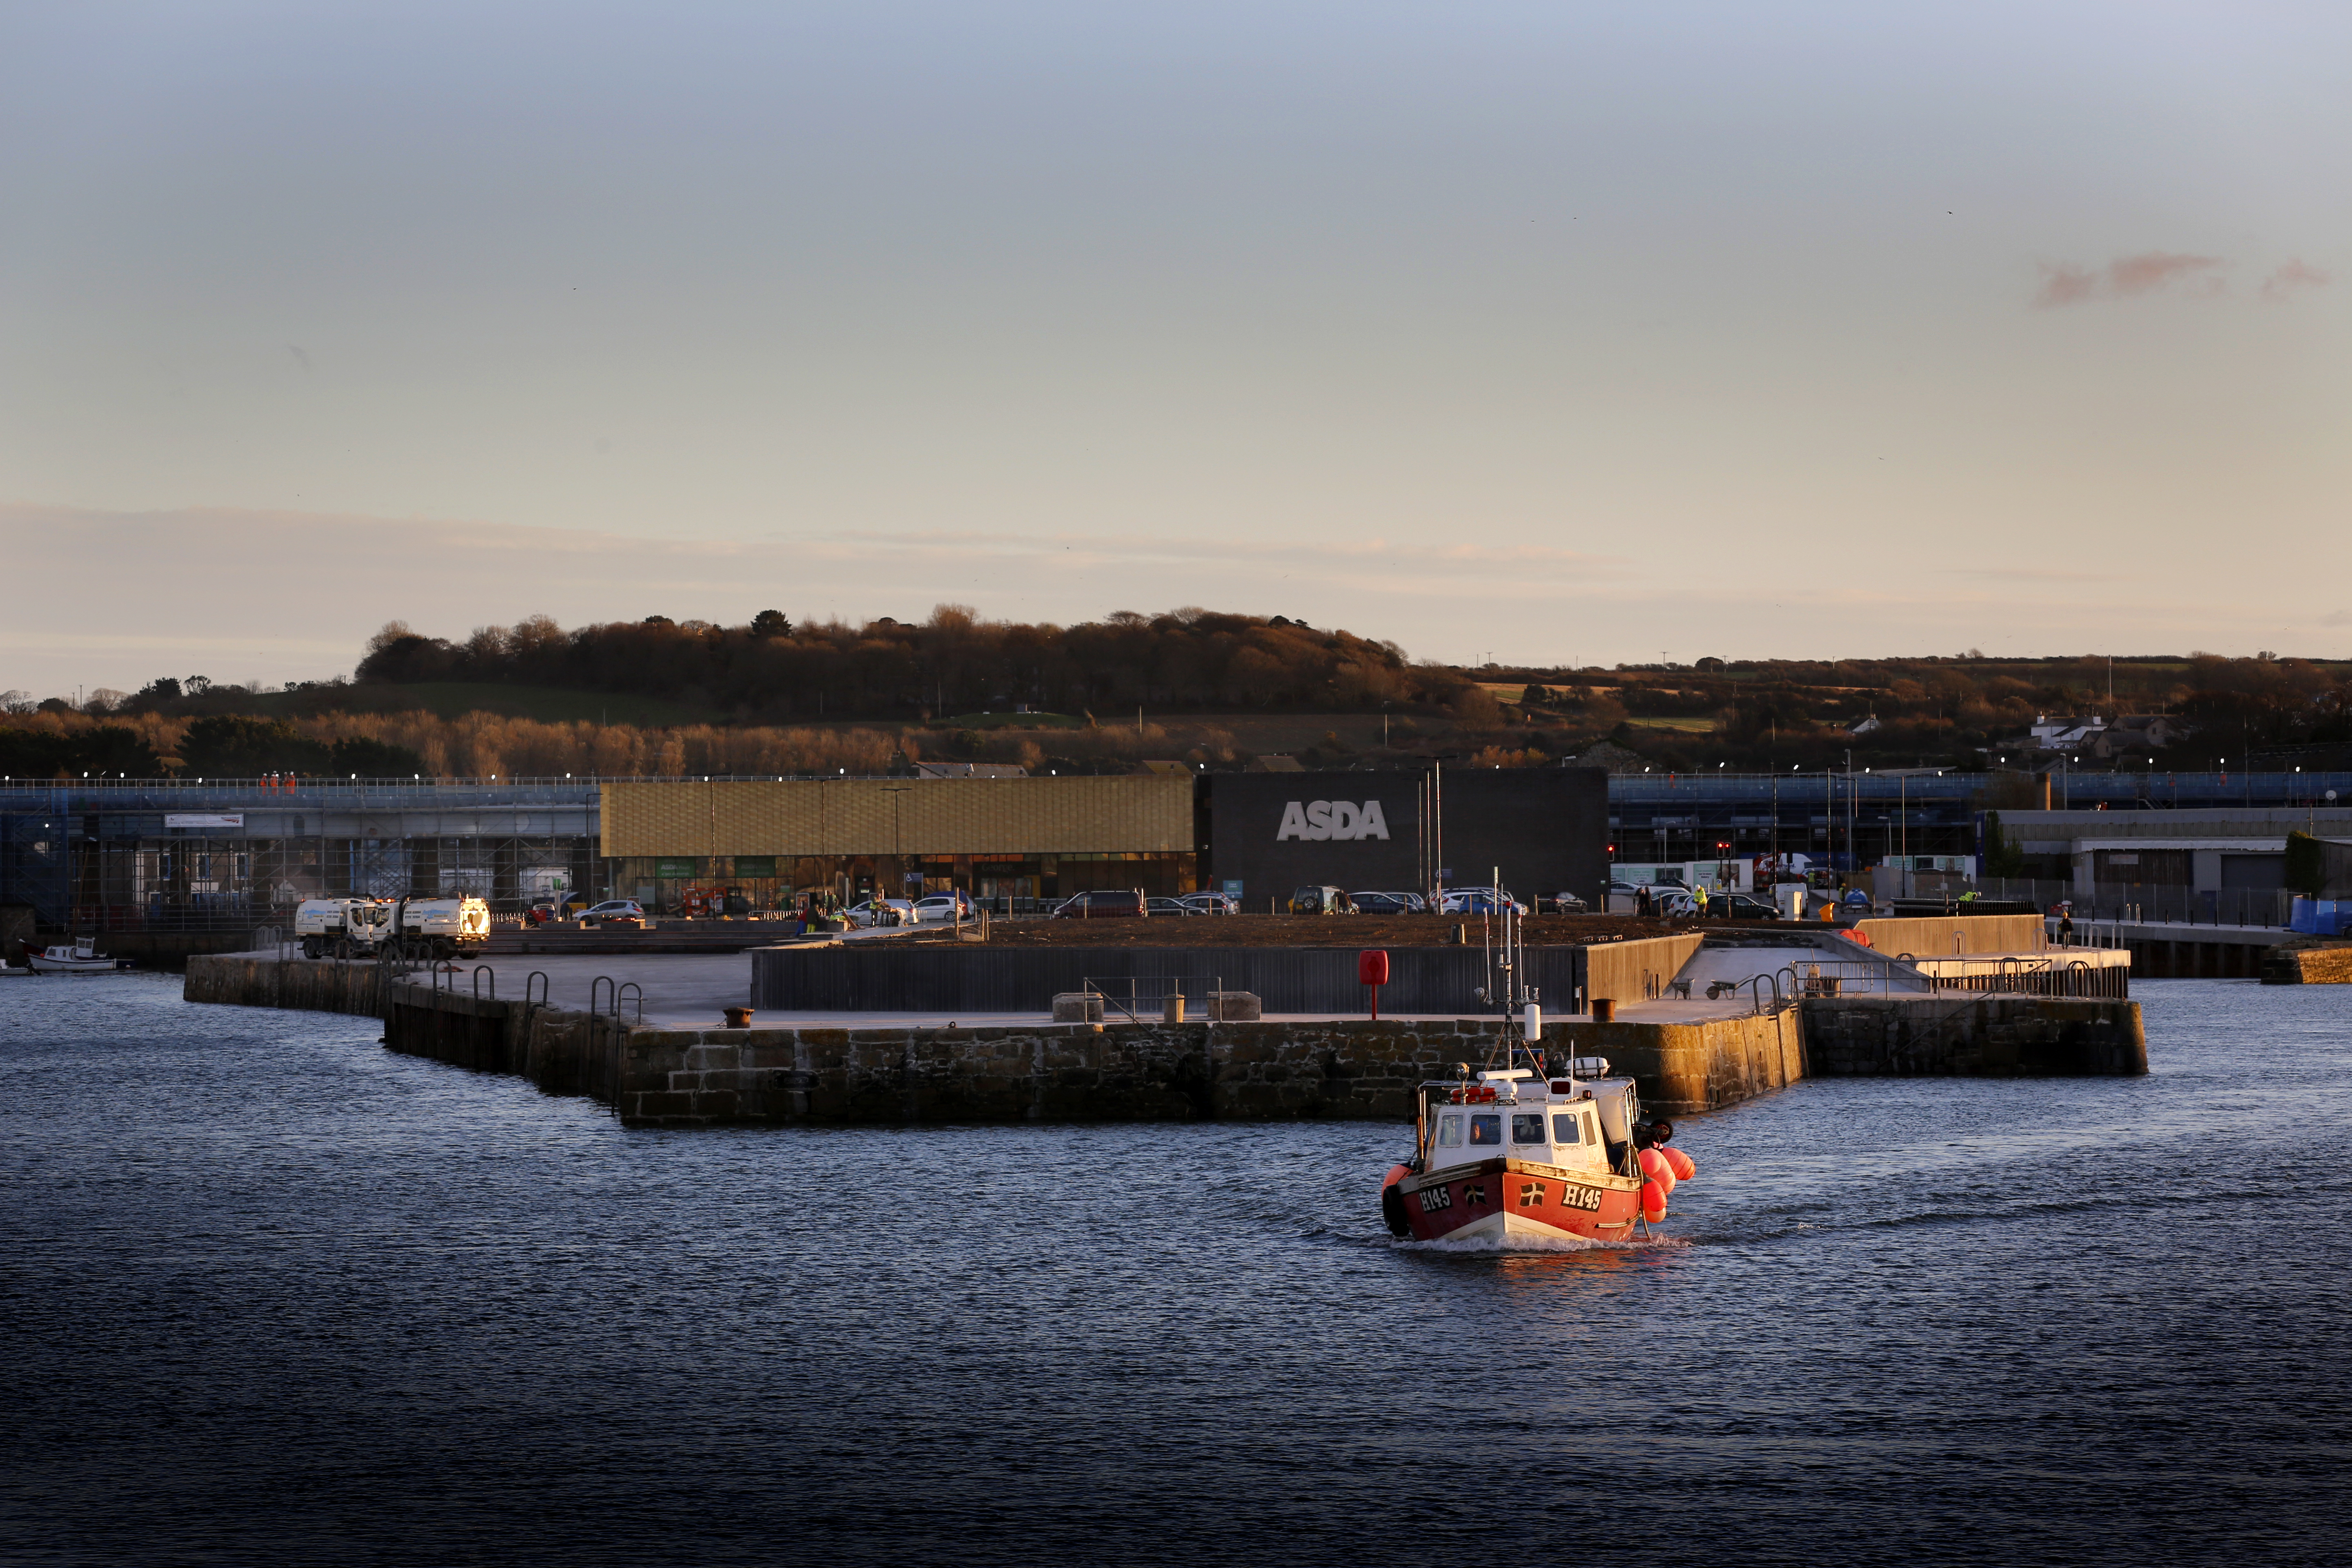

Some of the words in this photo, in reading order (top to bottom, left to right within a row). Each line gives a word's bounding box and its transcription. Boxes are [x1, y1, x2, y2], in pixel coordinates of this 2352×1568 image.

[1276, 800, 1390, 841] ASDA
[1419, 1187, 1450, 1211] H145
[1563, 1184, 1601, 1209] H145
